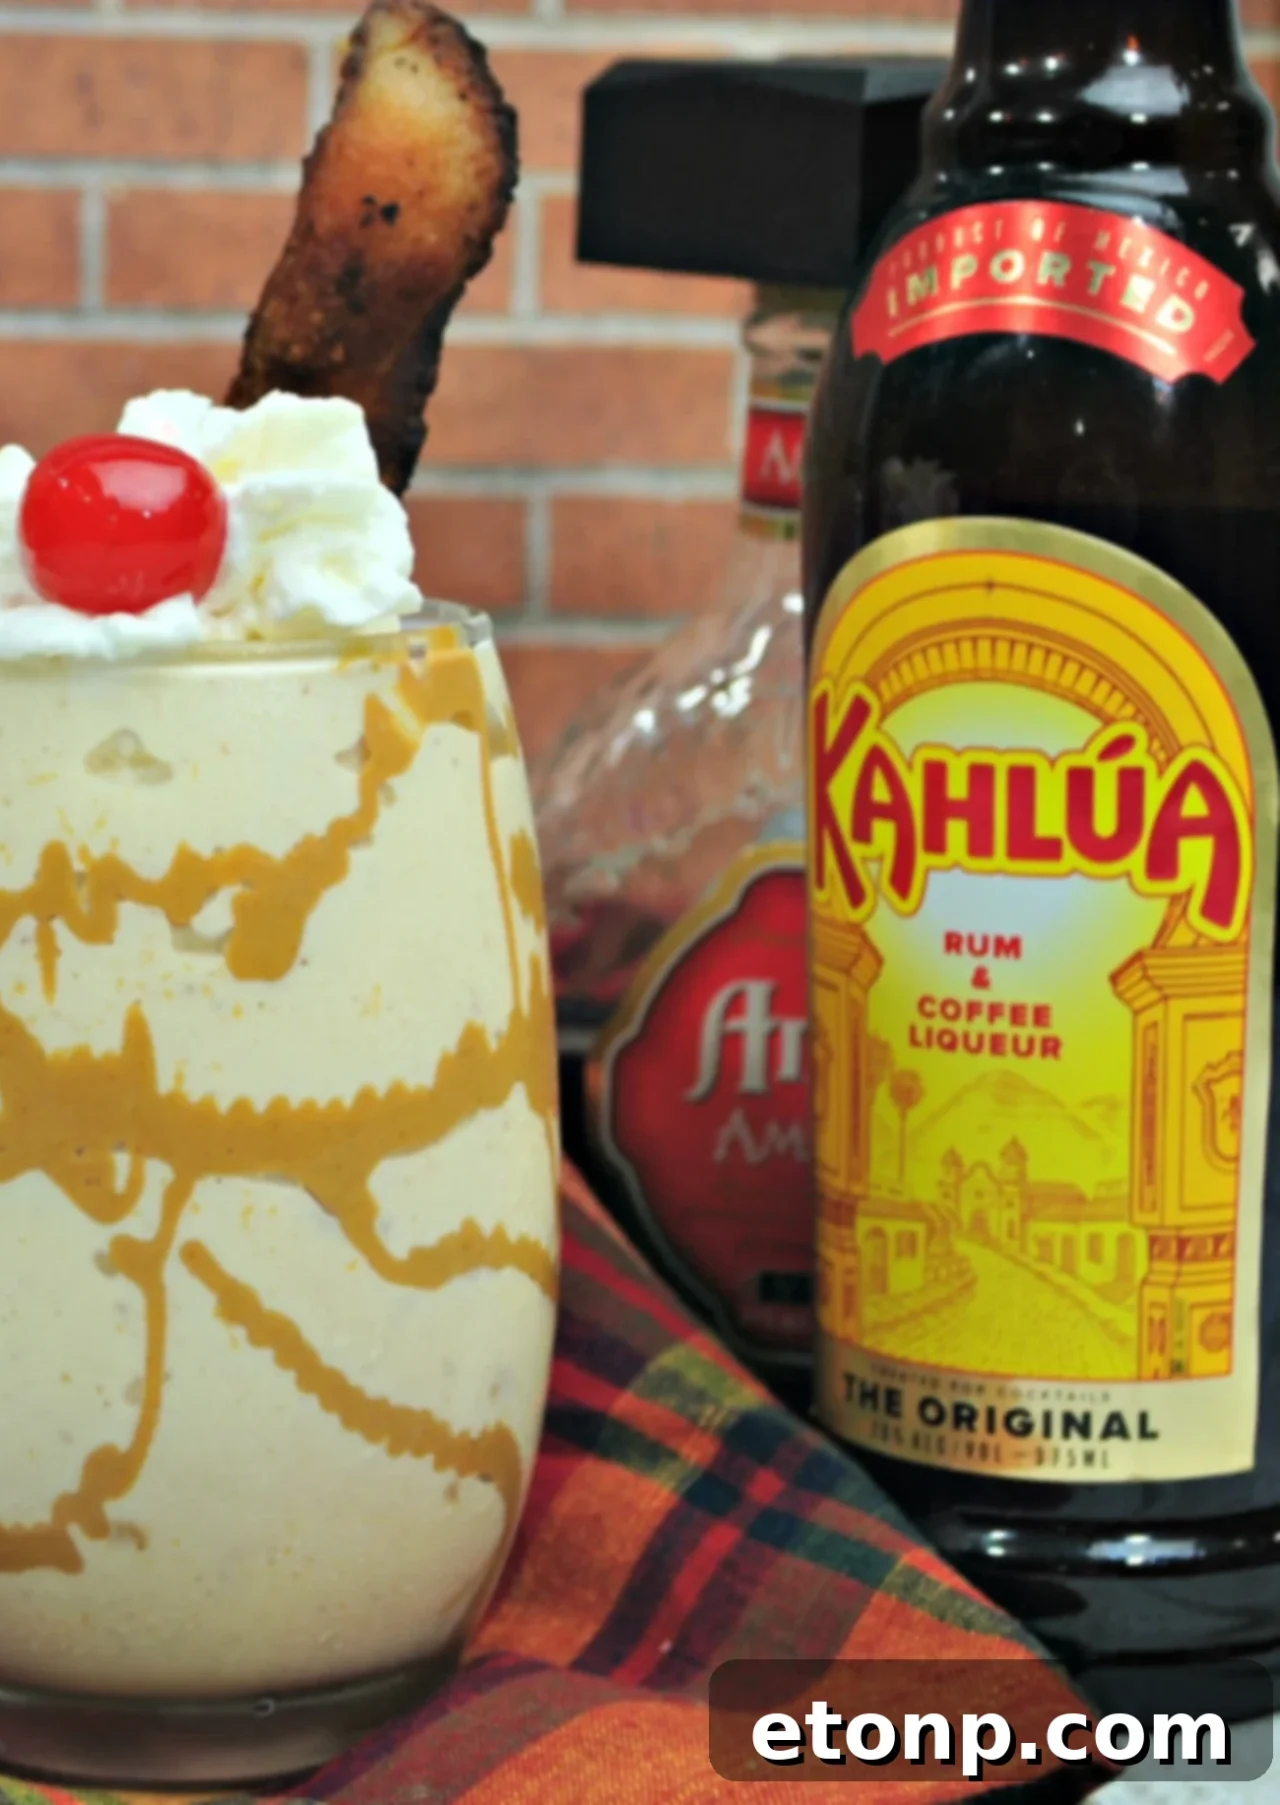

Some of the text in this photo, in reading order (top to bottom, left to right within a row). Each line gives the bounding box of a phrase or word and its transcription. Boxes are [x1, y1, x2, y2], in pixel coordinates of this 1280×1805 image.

[886, 248, 1195, 334] IMPORTED
[811, 688, 1242, 931] KAHLÚA
[942, 930, 1023, 961] RUM
[970, 965, 992, 990] &
[916, 994, 1052, 1029] COFFEE
[908, 1024, 1063, 1060] LIQUEUR
[842, 1371, 1161, 1442] THE ORIGINAL
